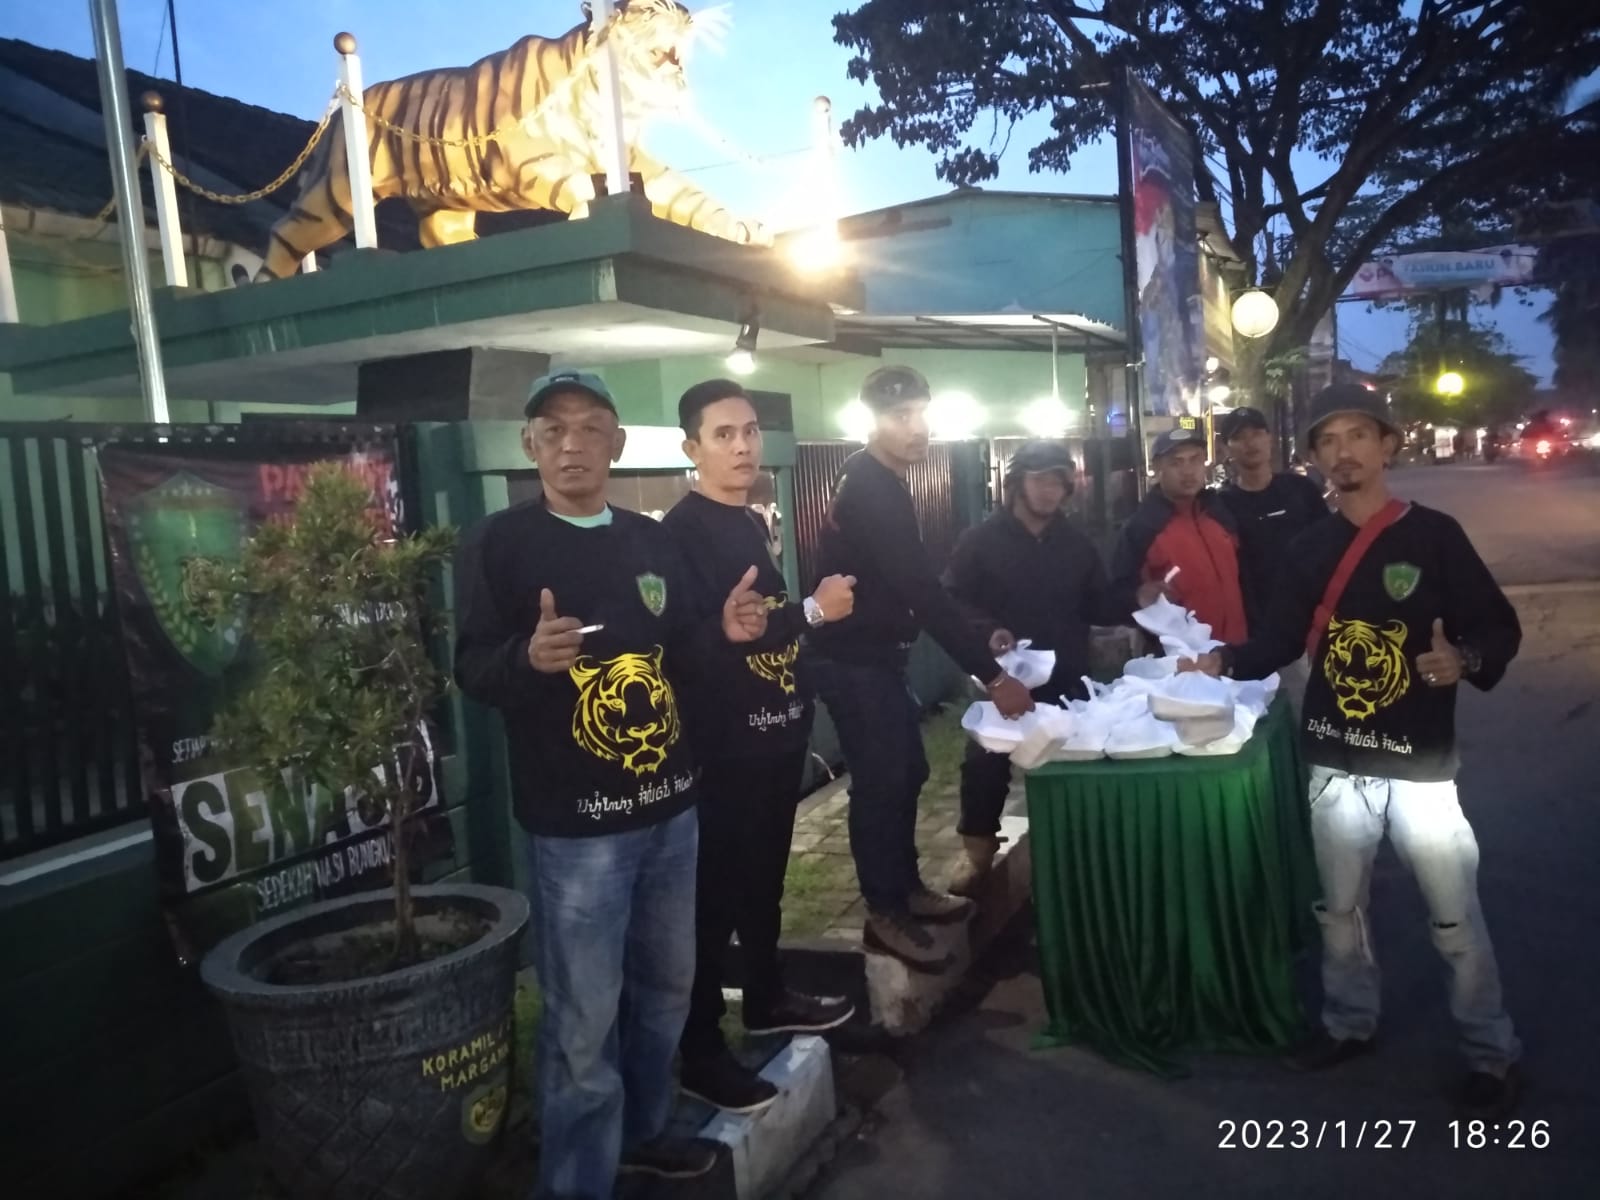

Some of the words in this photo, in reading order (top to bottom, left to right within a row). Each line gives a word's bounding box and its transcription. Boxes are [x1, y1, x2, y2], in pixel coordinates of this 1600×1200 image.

[1455, 259, 1496, 272] BARU
[257, 859, 314, 913] SEDEKAH
[314, 850, 346, 888] NASI
[421, 1032, 495, 1077] KORAMIL
